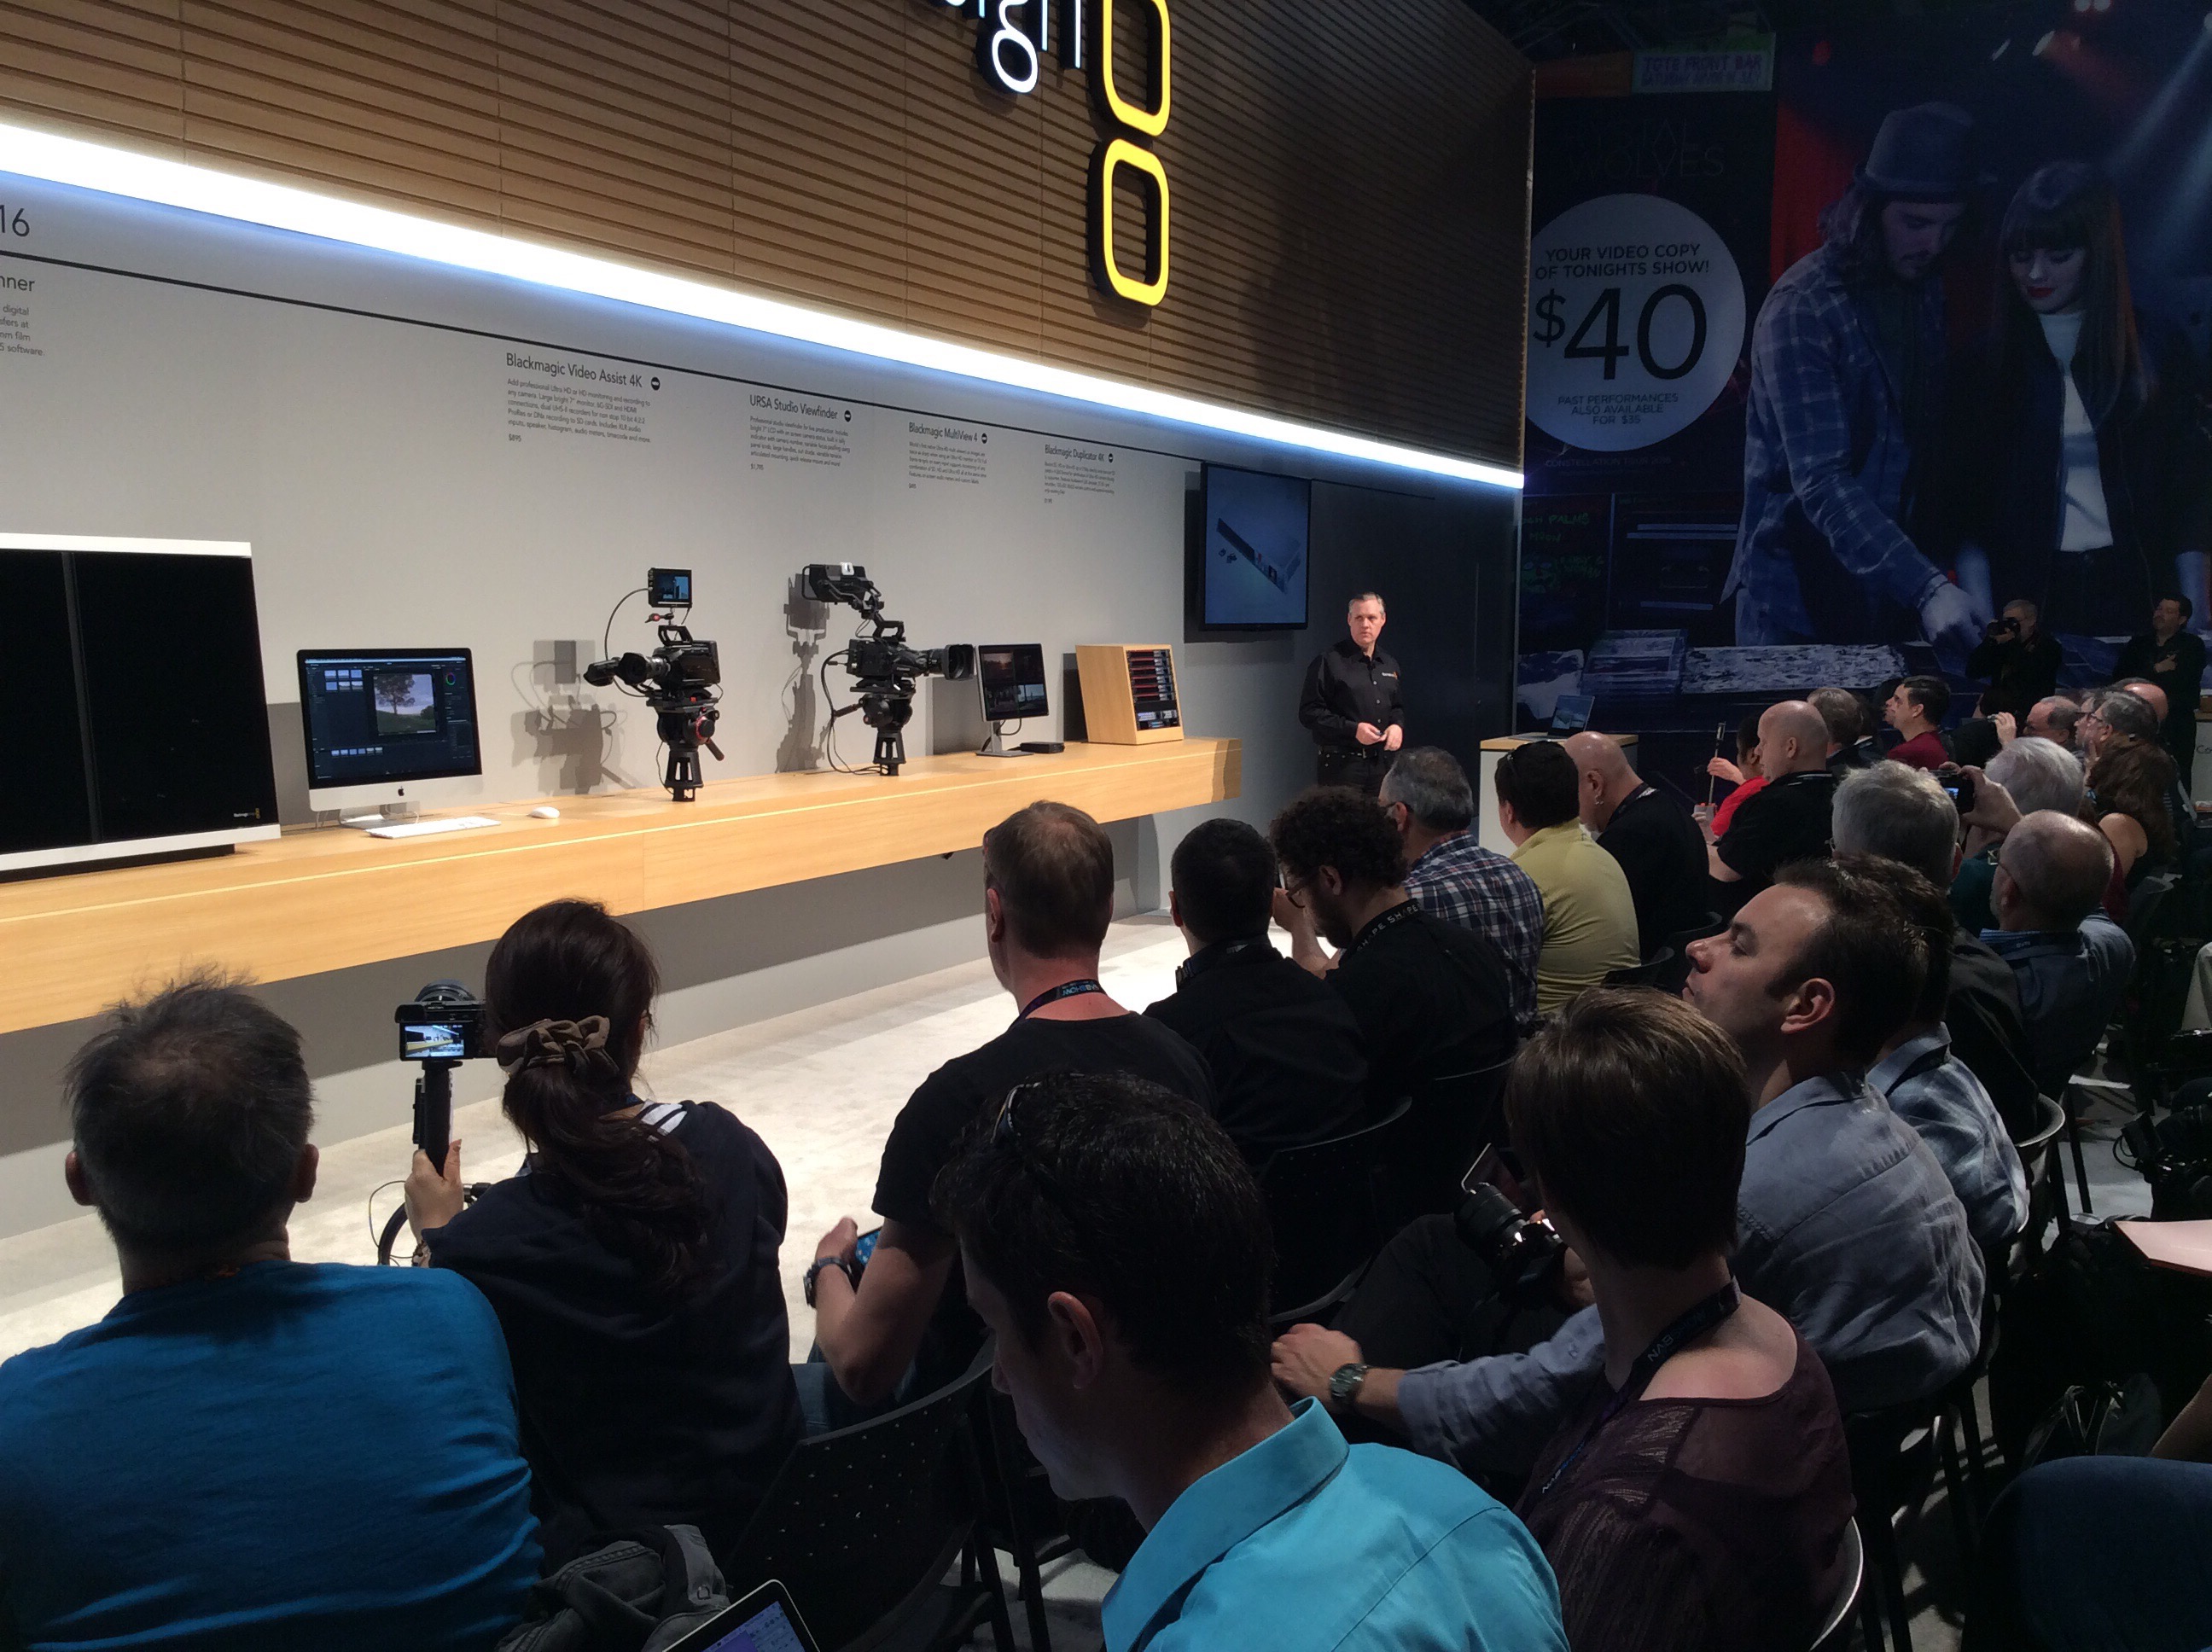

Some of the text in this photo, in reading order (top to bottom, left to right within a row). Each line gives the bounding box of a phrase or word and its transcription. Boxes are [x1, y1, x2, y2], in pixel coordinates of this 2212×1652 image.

[1546, 244, 1700, 262] YOUR VIDEO COPY
[1536, 259, 1709, 280] OF TONIGHTS SHOW!
[1533, 283, 1707, 380] $40
[506, 352, 643, 387] Blackmagic Video Assist 4K
[749, 394, 838, 420] URSA Studio Viewfinder
[1557, 393, 1679, 405] PAST PERFORMANCES
[1571, 404, 1664, 416] ALSO AVAILABLE
[1592, 415, 1641, 425] FOR $35
[909, 422, 943, 439] Blackmagic
